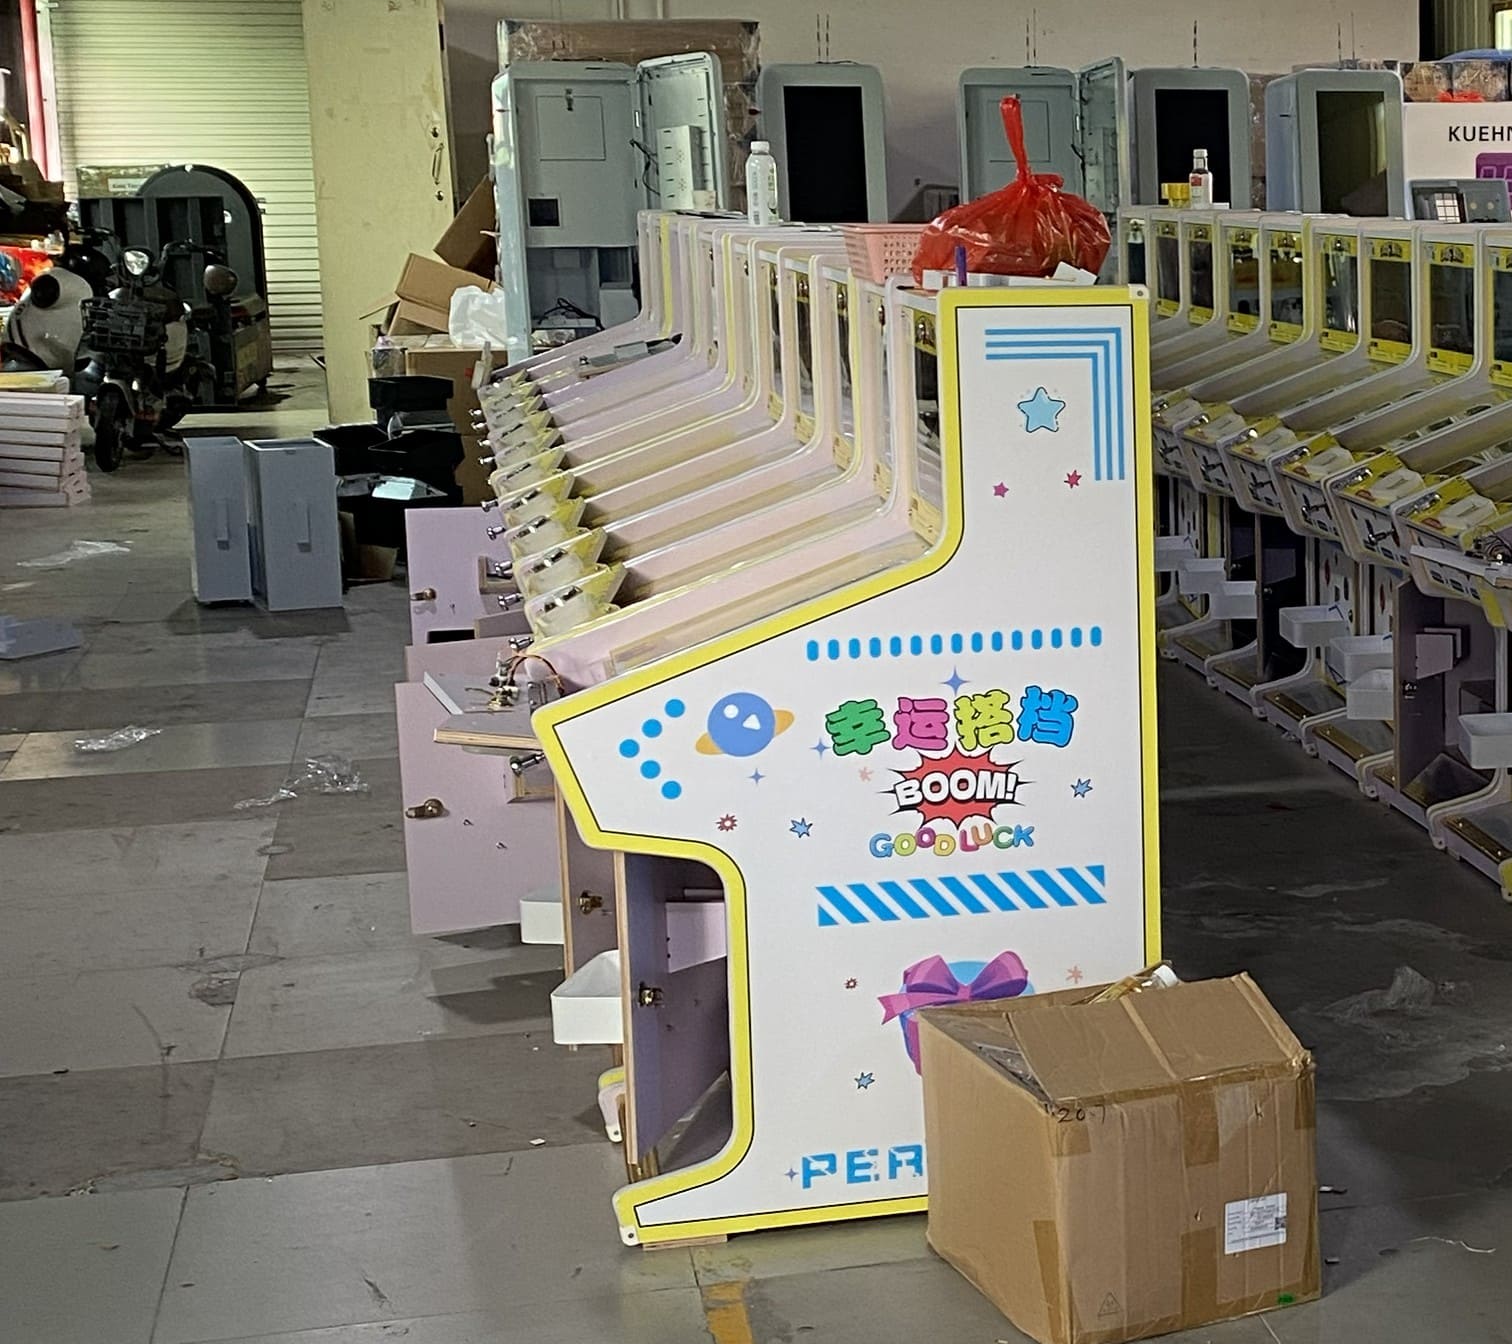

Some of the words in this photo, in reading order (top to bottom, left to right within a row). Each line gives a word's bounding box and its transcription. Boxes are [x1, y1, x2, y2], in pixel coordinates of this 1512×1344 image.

[825, 685, 1079, 757] 幸运搭档
[893, 767, 1019, 808] BOOM!
[869, 827, 956, 859] GOOD
[959, 822, 1036, 853] LUCK
